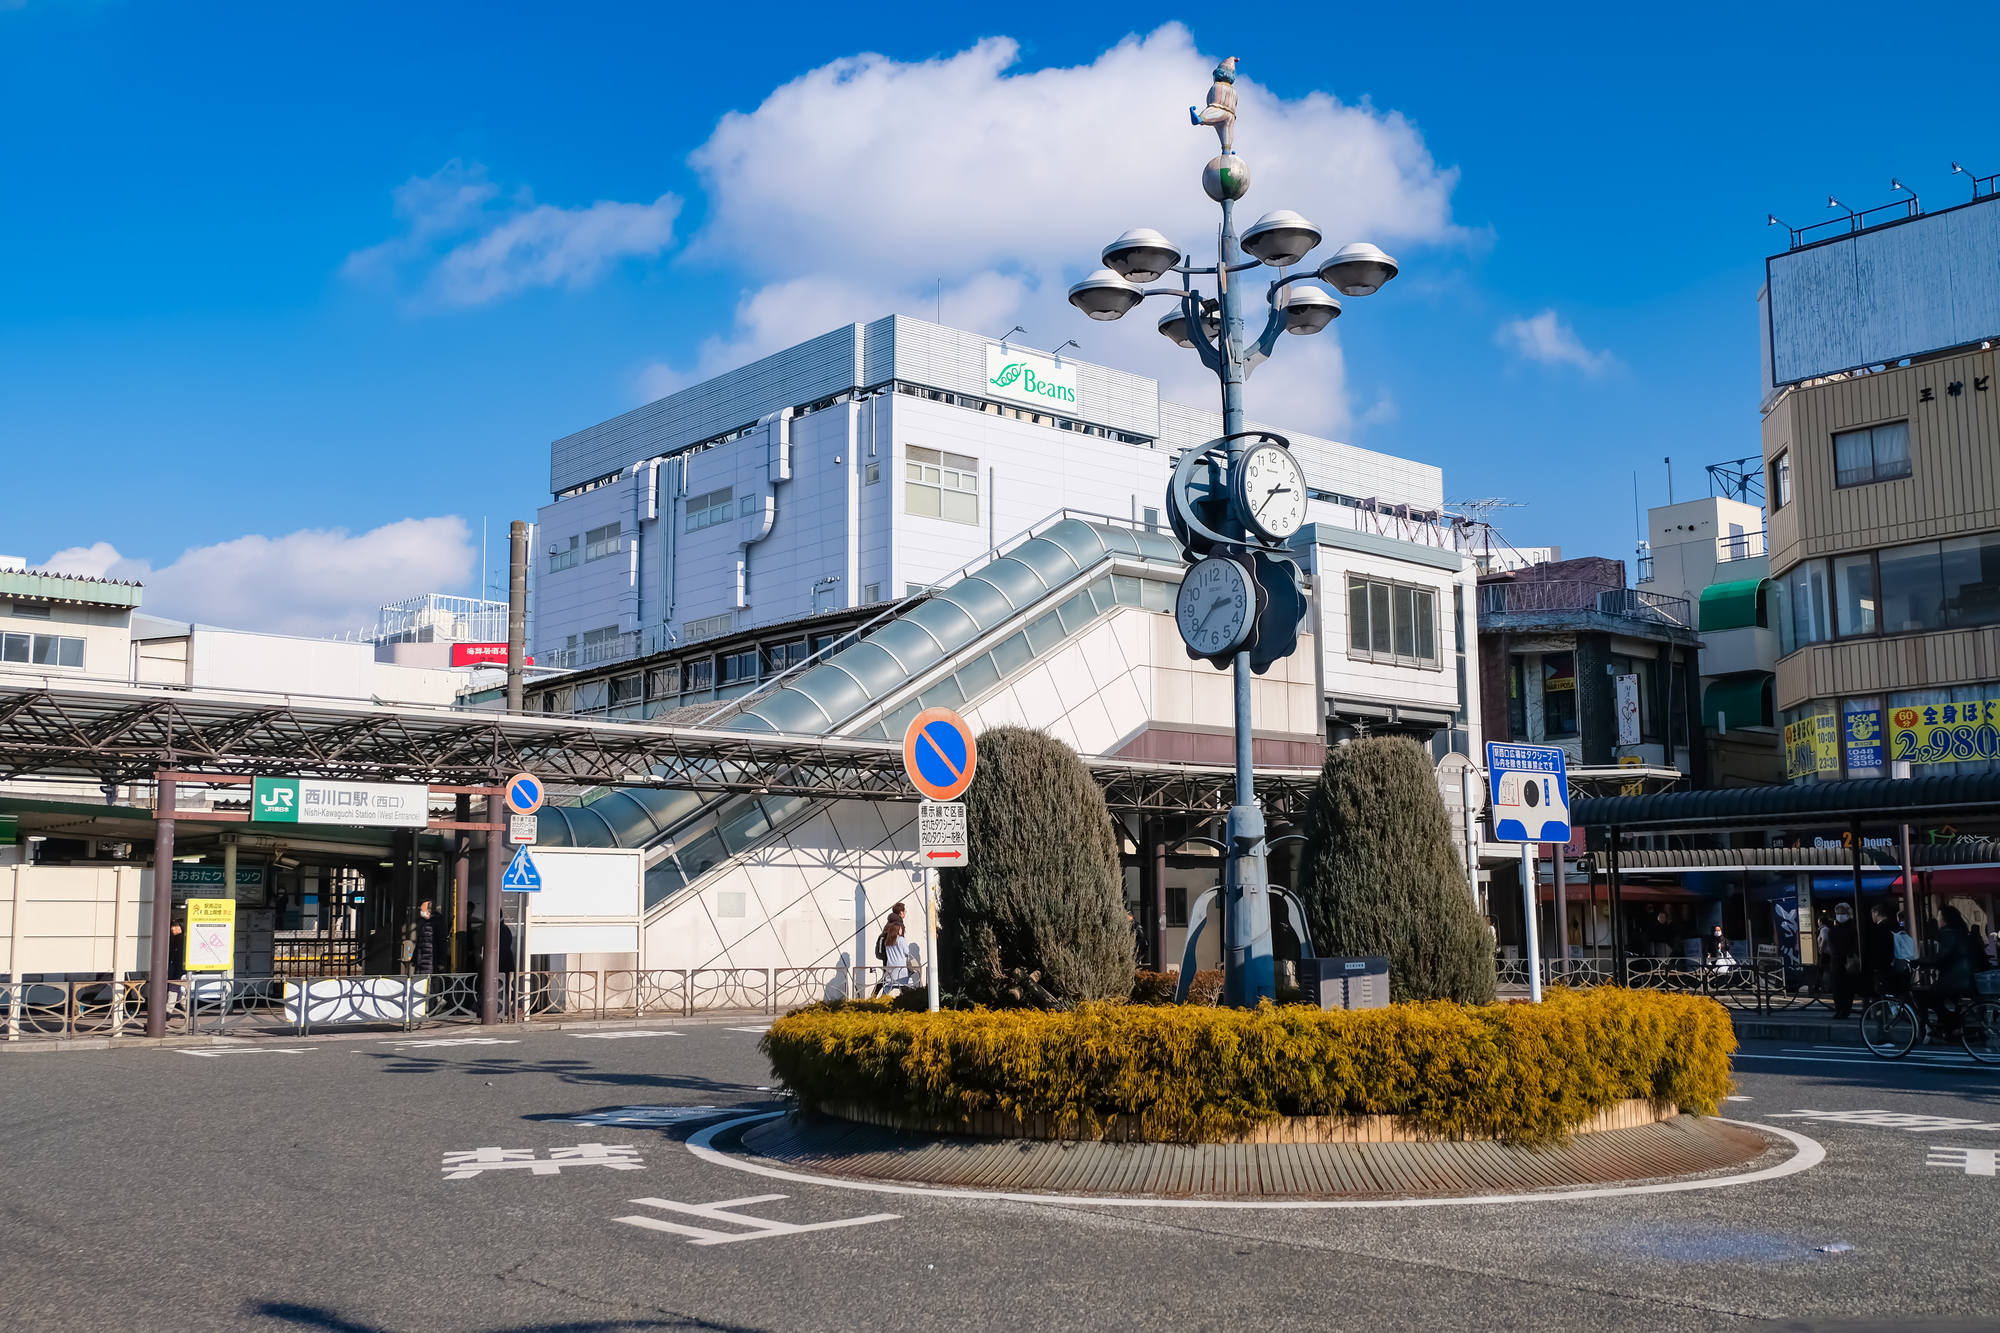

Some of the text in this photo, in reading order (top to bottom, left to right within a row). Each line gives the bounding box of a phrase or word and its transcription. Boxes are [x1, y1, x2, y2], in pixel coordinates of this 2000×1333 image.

[1024, 369, 1075, 403] Beans
[1257, 454, 1264, 466] 11
[1268, 452, 1277, 464] 12
[1281, 459, 1285, 470] 1
[1249, 465, 1259, 477] 10
[1289, 472, 1295, 483] 2
[1246, 480, 1253, 492] 9
[1293, 490, 1300, 502] 3
[1251, 499, 1258, 511] 8
[1261, 513, 1267, 525] 7
[1290, 507, 1296, 518] 4
[1271, 519, 1278, 531] 6
[1282, 517, 1288, 528] 5
[1199, 573, 1208, 587] 11
[1209, 567, 1220, 582] 12
[1231, 578, 1239, 593] 2
[1189, 587, 1201, 601] 10
[1234, 594, 1243, 609] 3
[1187, 604, 1195, 618] 9
[1231, 611, 1240, 625] 4
[1191, 618, 1199, 632] 8
[1200, 629, 1208, 643] 7
[1211, 631, 1219, 645] 6
[1222, 625, 1231, 639] 5
[1898, 711, 1913, 721] 60
[1818, 731, 1836, 744] 10:00
[1895, 723, 2000, 764] 2,980
[1819, 756, 1837, 769] 23:30
[260, 787, 294, 807] JR
[303, 807, 421, 821] Nishi-Kawaguchi Station (West Entrance)
[921, 805, 964, 818] 標示線で区画
[1863, 836, 1893, 849] hours
[441, 1142, 648, 1180] 禁
[611, 1193, 905, 1246] 止
